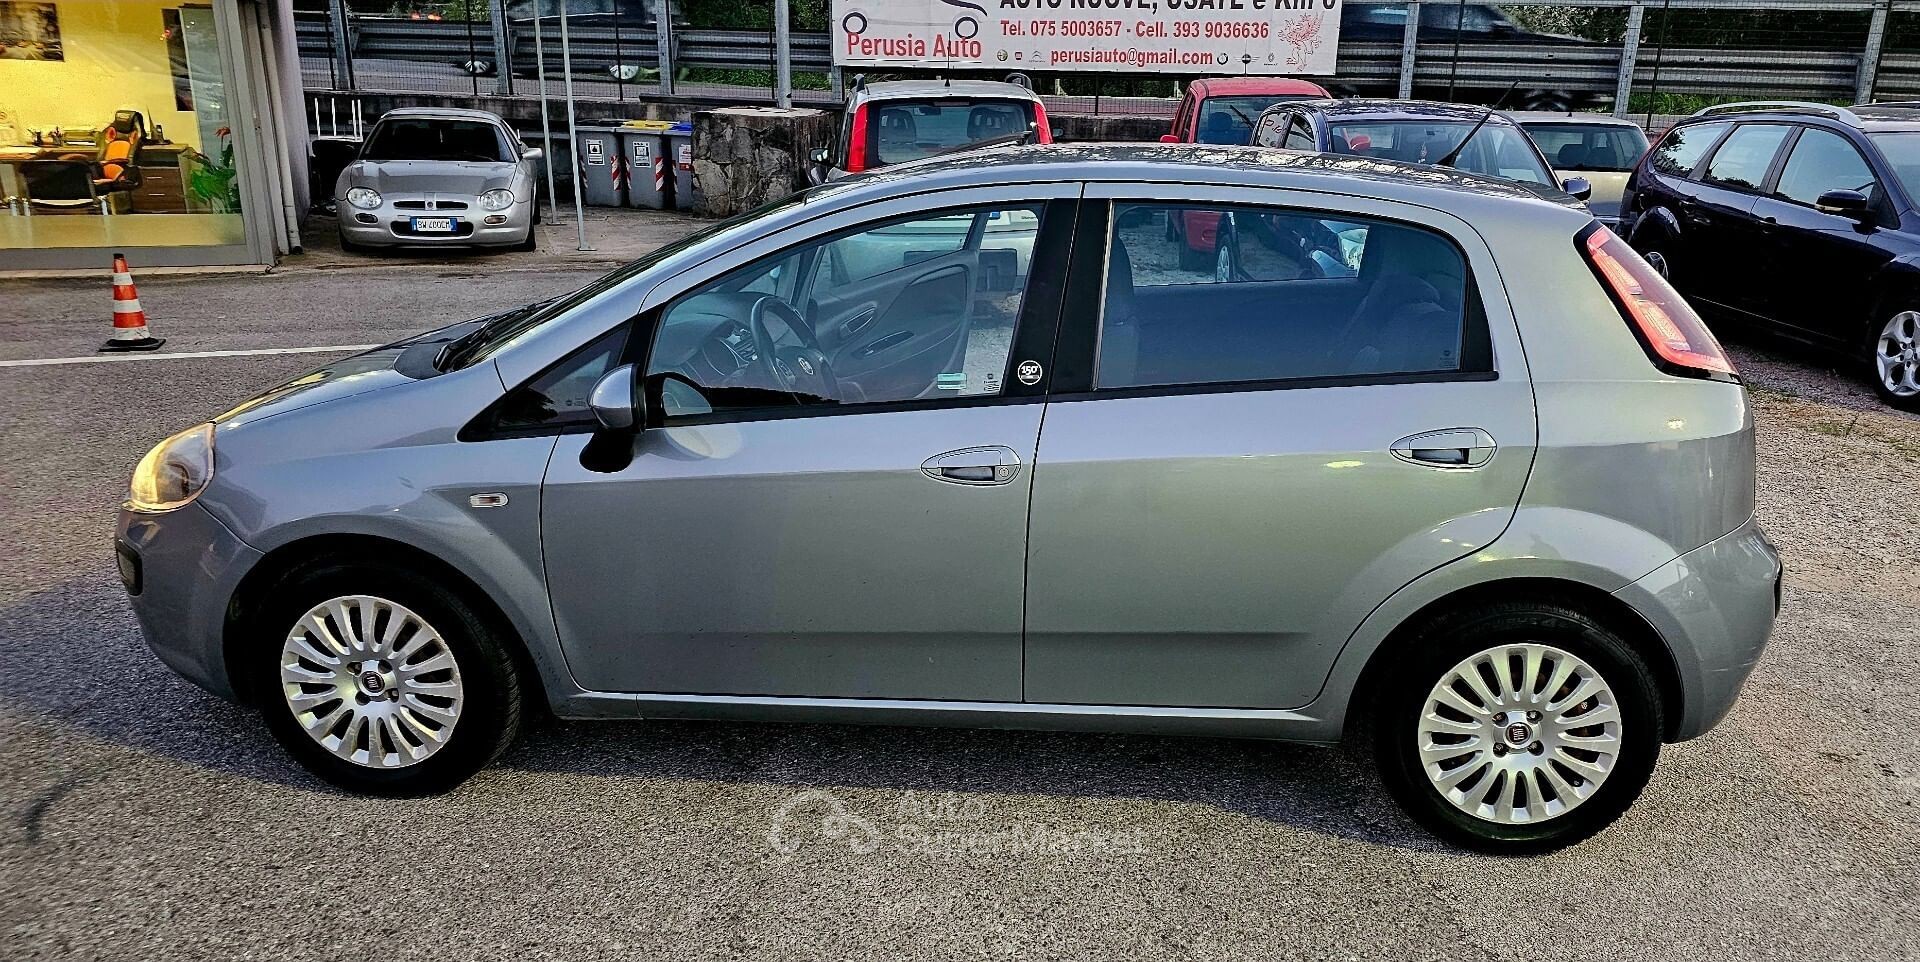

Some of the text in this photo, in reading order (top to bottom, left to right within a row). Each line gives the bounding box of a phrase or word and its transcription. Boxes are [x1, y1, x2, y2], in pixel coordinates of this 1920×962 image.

[1000, 20, 1026, 36] Tel.
[1030, 20, 1056, 36] 075
[1060, 20, 1122, 37] 5003657
[1135, 21, 1168, 38] Cell.
[1173, 21, 1200, 38] 393
[1205, 21, 1269, 38] 9036636
[847, 32, 982, 58] Perusia Auto
[1050, 46, 1213, 67] perusiauto@gmail.com
